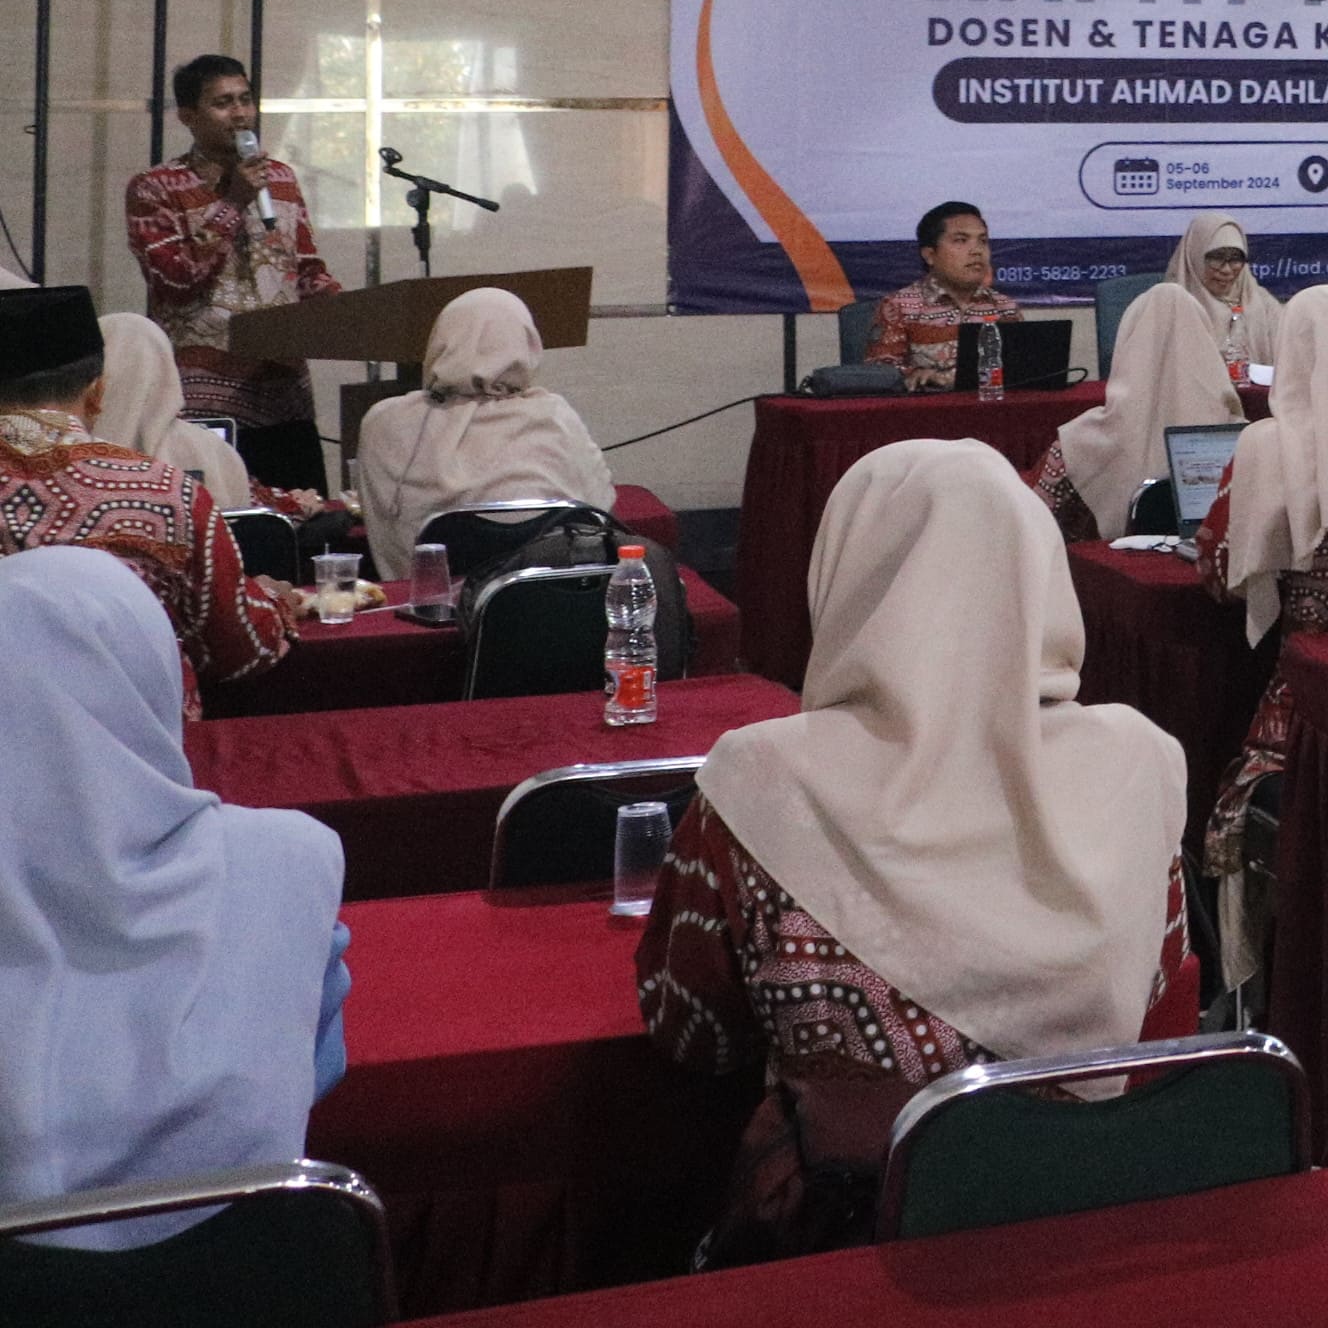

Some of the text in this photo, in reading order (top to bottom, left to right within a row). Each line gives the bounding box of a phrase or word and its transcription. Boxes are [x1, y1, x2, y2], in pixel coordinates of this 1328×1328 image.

[928, 18, 1071, 47] DOSEN
[1088, 20, 1116, 48] &
[1133, 20, 1298, 49] TENAGA
[959, 78, 1104, 104] INSTITUT
[1111, 79, 1232, 104] AHMAD
[1166, 162, 1210, 175] 05-06
[1166, 176, 1280, 191] September 2024
[997, 265, 1127, 282] 0813-5828-2233
